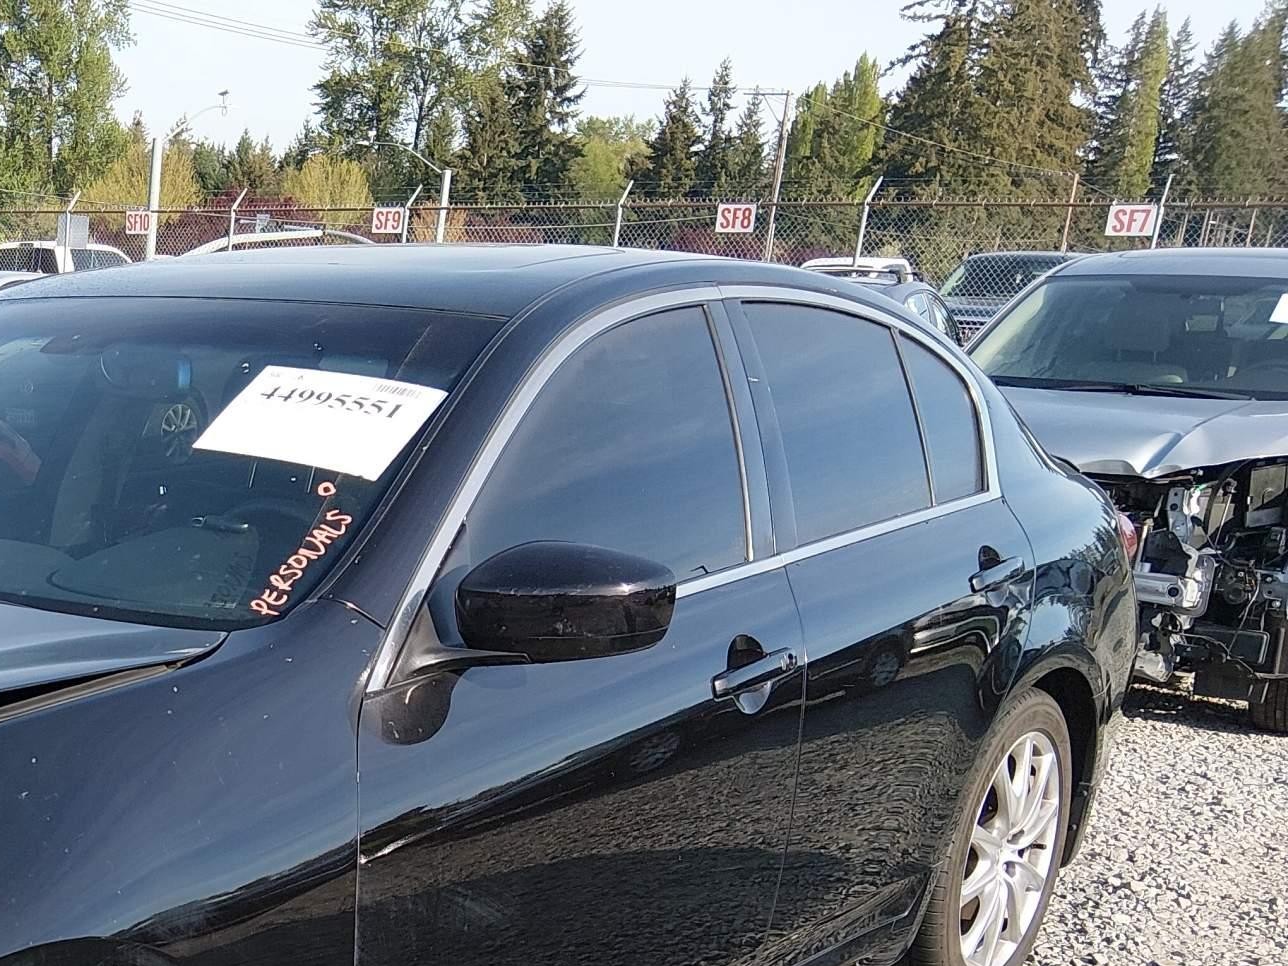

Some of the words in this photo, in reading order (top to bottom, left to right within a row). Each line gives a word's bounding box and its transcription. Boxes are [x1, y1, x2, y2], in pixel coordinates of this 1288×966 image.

[127, 213, 150, 232] SF10
[375, 210, 401, 230] SF9
[719, 207, 752, 229] SF8
[1112, 209, 1152, 233] SF7
[260, 385, 403, 419] 44995551
[250, 509, 353, 616] PERSONALS
